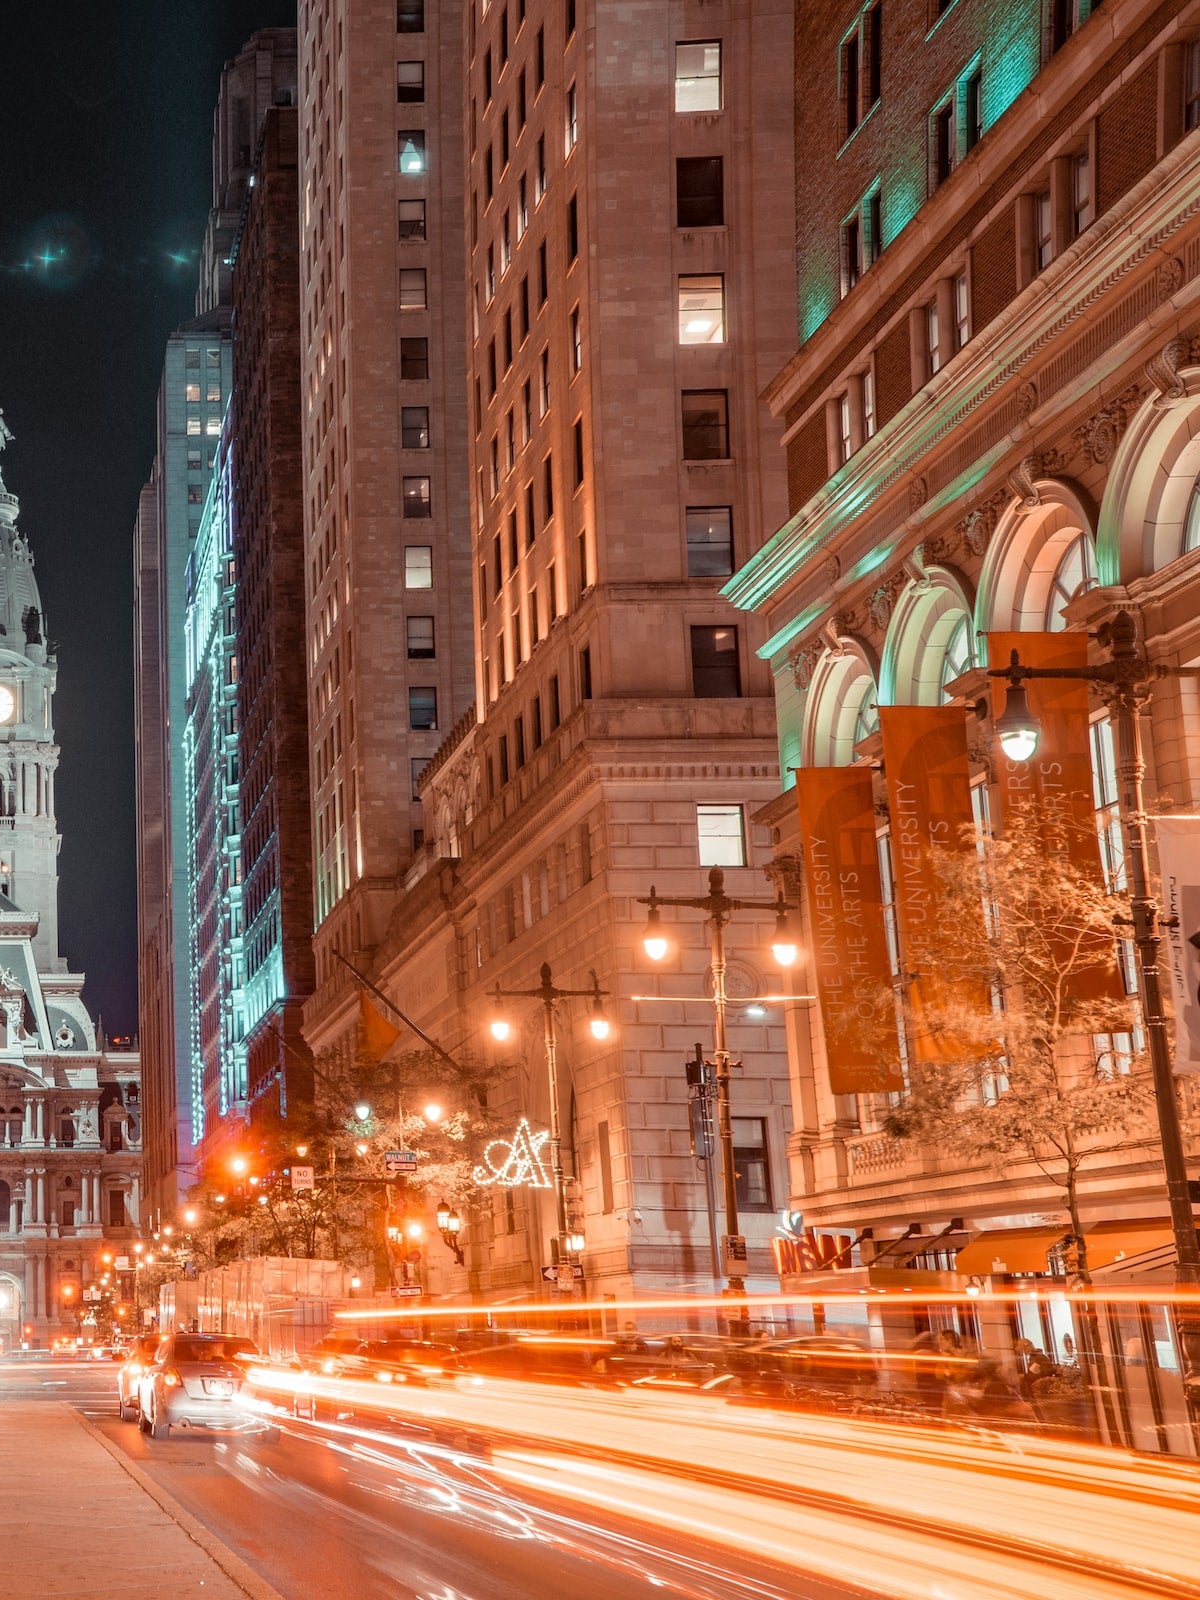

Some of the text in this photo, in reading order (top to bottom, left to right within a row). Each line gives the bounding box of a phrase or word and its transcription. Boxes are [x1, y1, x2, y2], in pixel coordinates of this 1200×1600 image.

[839, 871, 863, 927] ARTS
[895, 778, 928, 922] UNIVERSITY
[808, 834, 845, 1020] THE UNIVERSITY
[846, 936, 871, 982] THE
